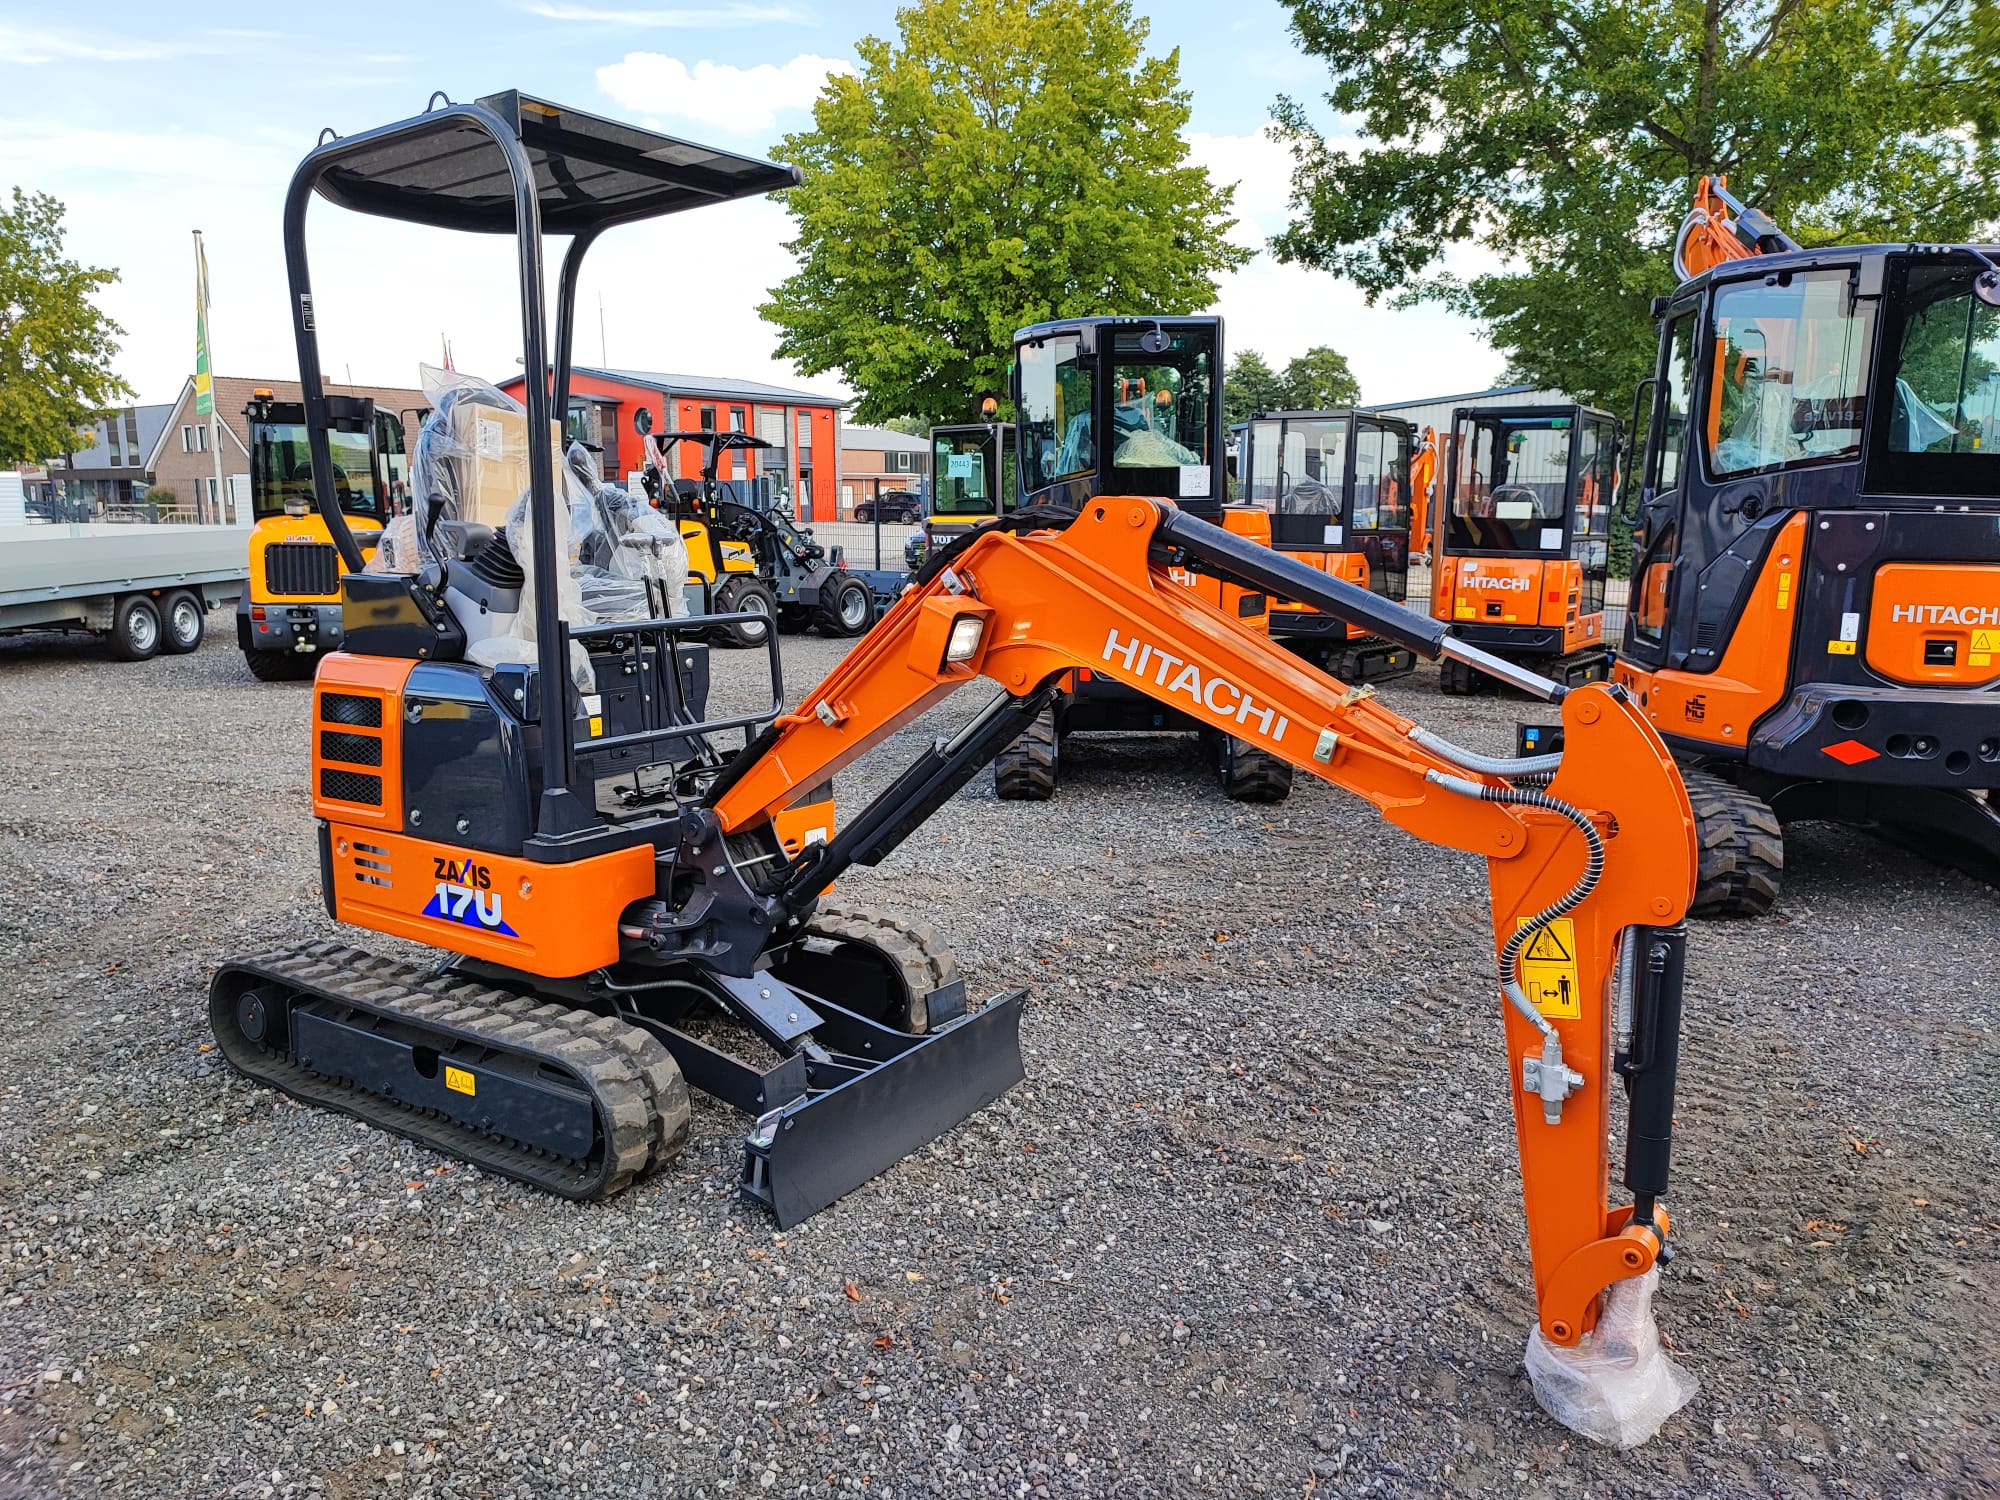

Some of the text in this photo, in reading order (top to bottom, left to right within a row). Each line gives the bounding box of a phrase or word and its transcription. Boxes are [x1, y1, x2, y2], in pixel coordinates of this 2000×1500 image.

[1463, 576, 1530, 591] HITACHI
[1892, 604, 2000, 625] HITACH
[1101, 628, 1289, 742] HITACHI
[433, 857, 491, 889] ZAXIS
[435, 881, 502, 929] 17U
